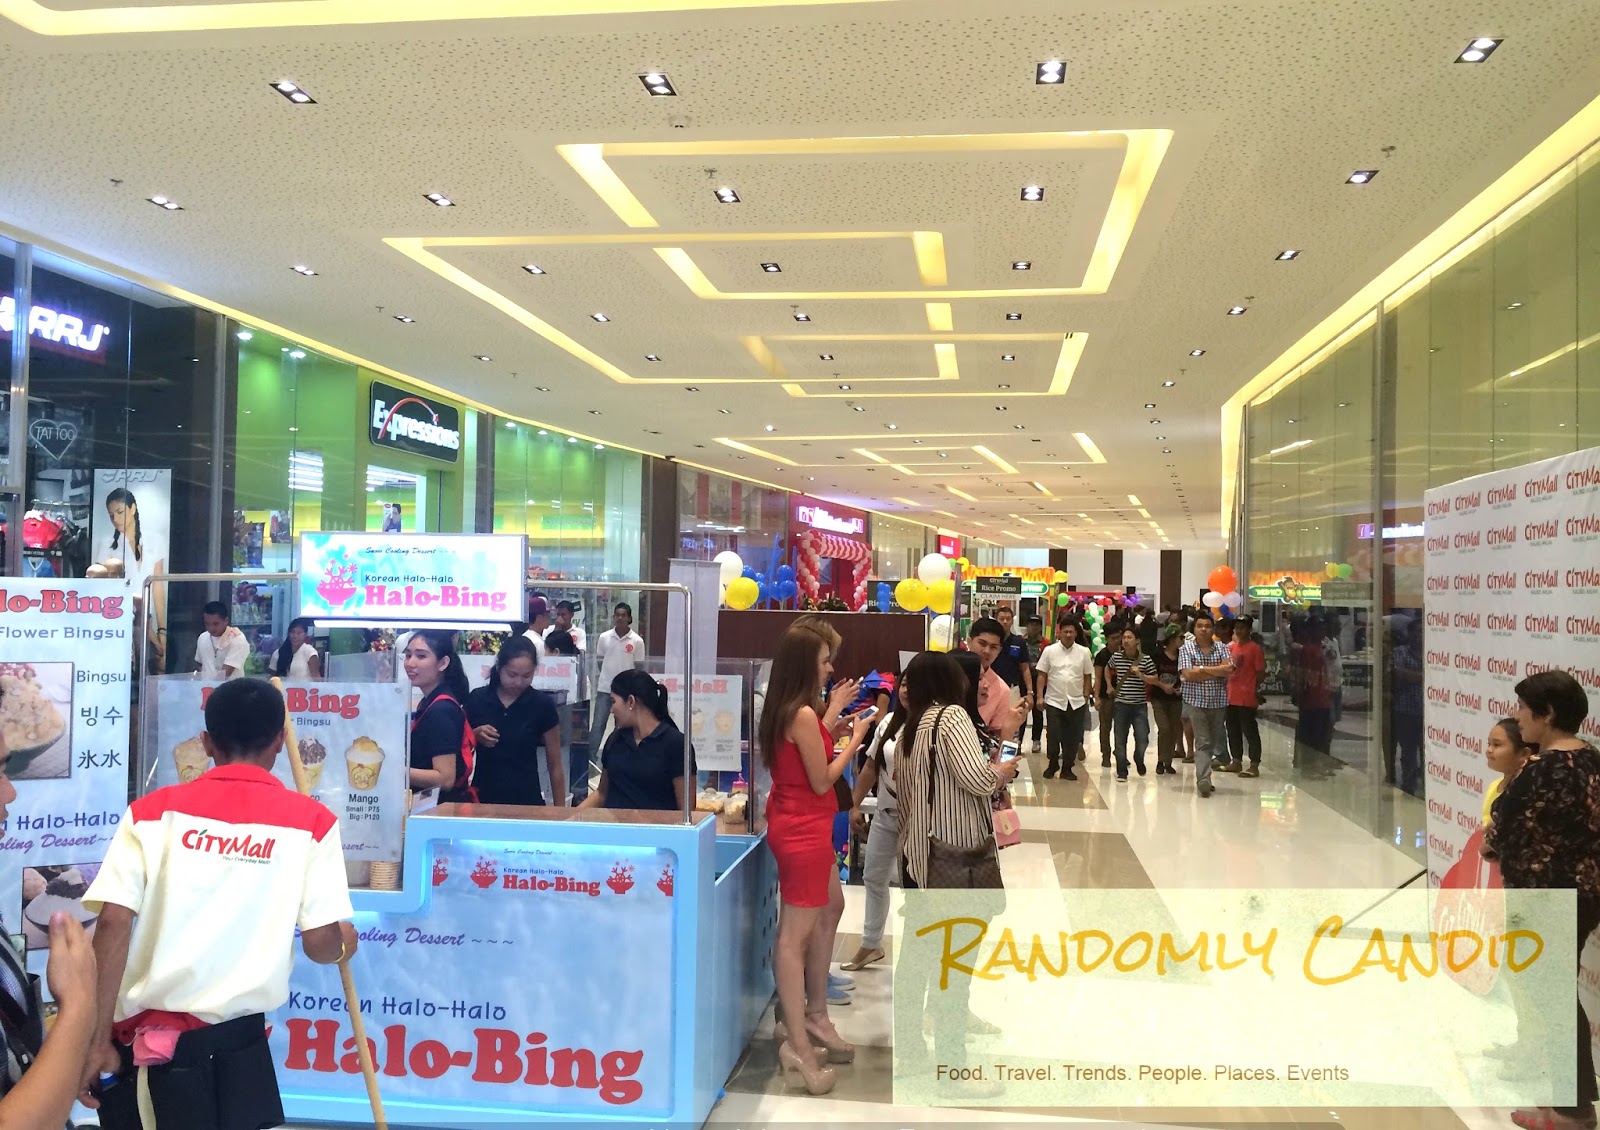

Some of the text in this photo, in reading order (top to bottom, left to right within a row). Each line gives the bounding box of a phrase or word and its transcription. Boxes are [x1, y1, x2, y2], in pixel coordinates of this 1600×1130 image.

[29, 305, 104, 351] RRJ
[365, 574, 454, 583] Korean Halo-Halo
[0, 588, 125, 619] lo-Bing
[364, 584, 508, 613] Halo-Bing
[63, 626, 125, 640] Bingsu
[76, 669, 127, 685] Bingsu
[80, 705, 124, 727] 빙수
[296, 716, 332, 727] Bingsu
[345, 805, 364, 813] Small
[368, 805, 380, 813] P75
[348, 793, 379, 805] Mango
[17, 811, 120, 831] Halo-Halo
[349, 813, 360, 821] Big
[364, 813, 380, 821] P120
[0, 836, 34, 854] oling
[502, 874, 601, 897] Halo-Bing
[358, 926, 465, 948] oling Dessert
[381, 995, 507, 1021] Halo-Halo
[284, 1017, 644, 1105] Halo-Bing
